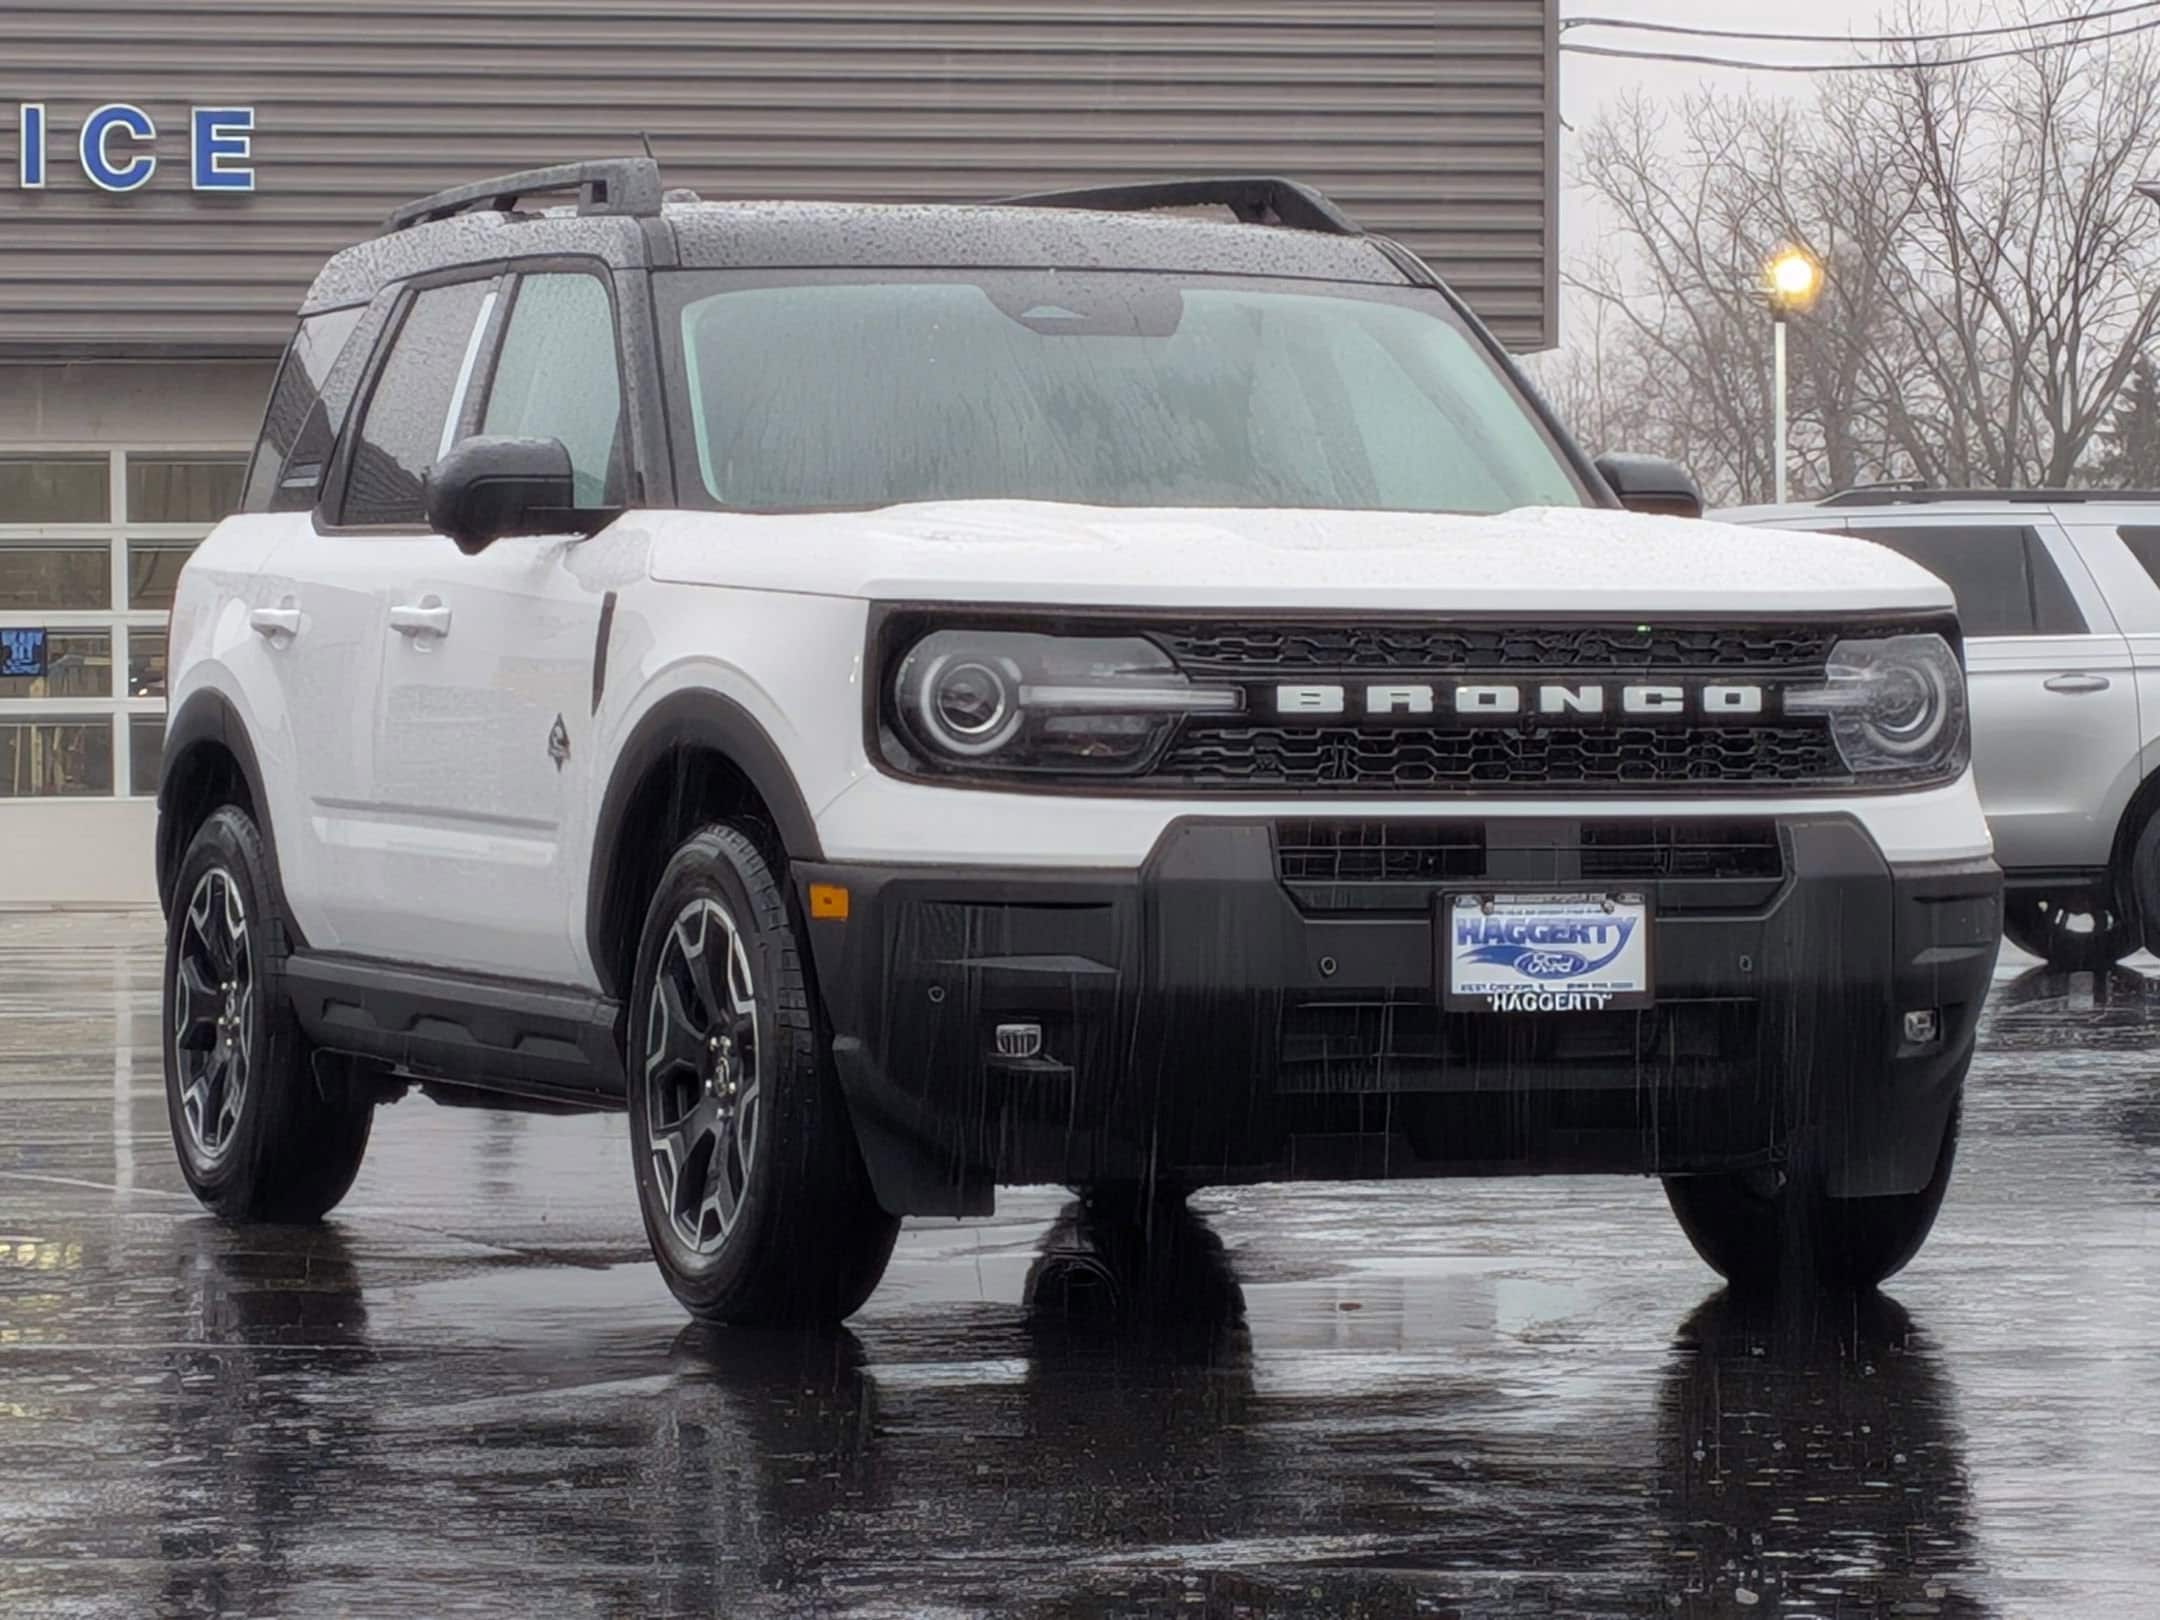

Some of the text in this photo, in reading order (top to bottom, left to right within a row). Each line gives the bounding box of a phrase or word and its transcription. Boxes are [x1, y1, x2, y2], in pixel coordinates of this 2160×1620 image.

[20, 102, 255, 191] ICE
[1276, 685, 1763, 713] BRONCO
[1457, 917, 1637, 945] HAGGERTY
[1527, 952, 1574, 974] Ford
[1492, 992, 1613, 1012] HAGGERTY
